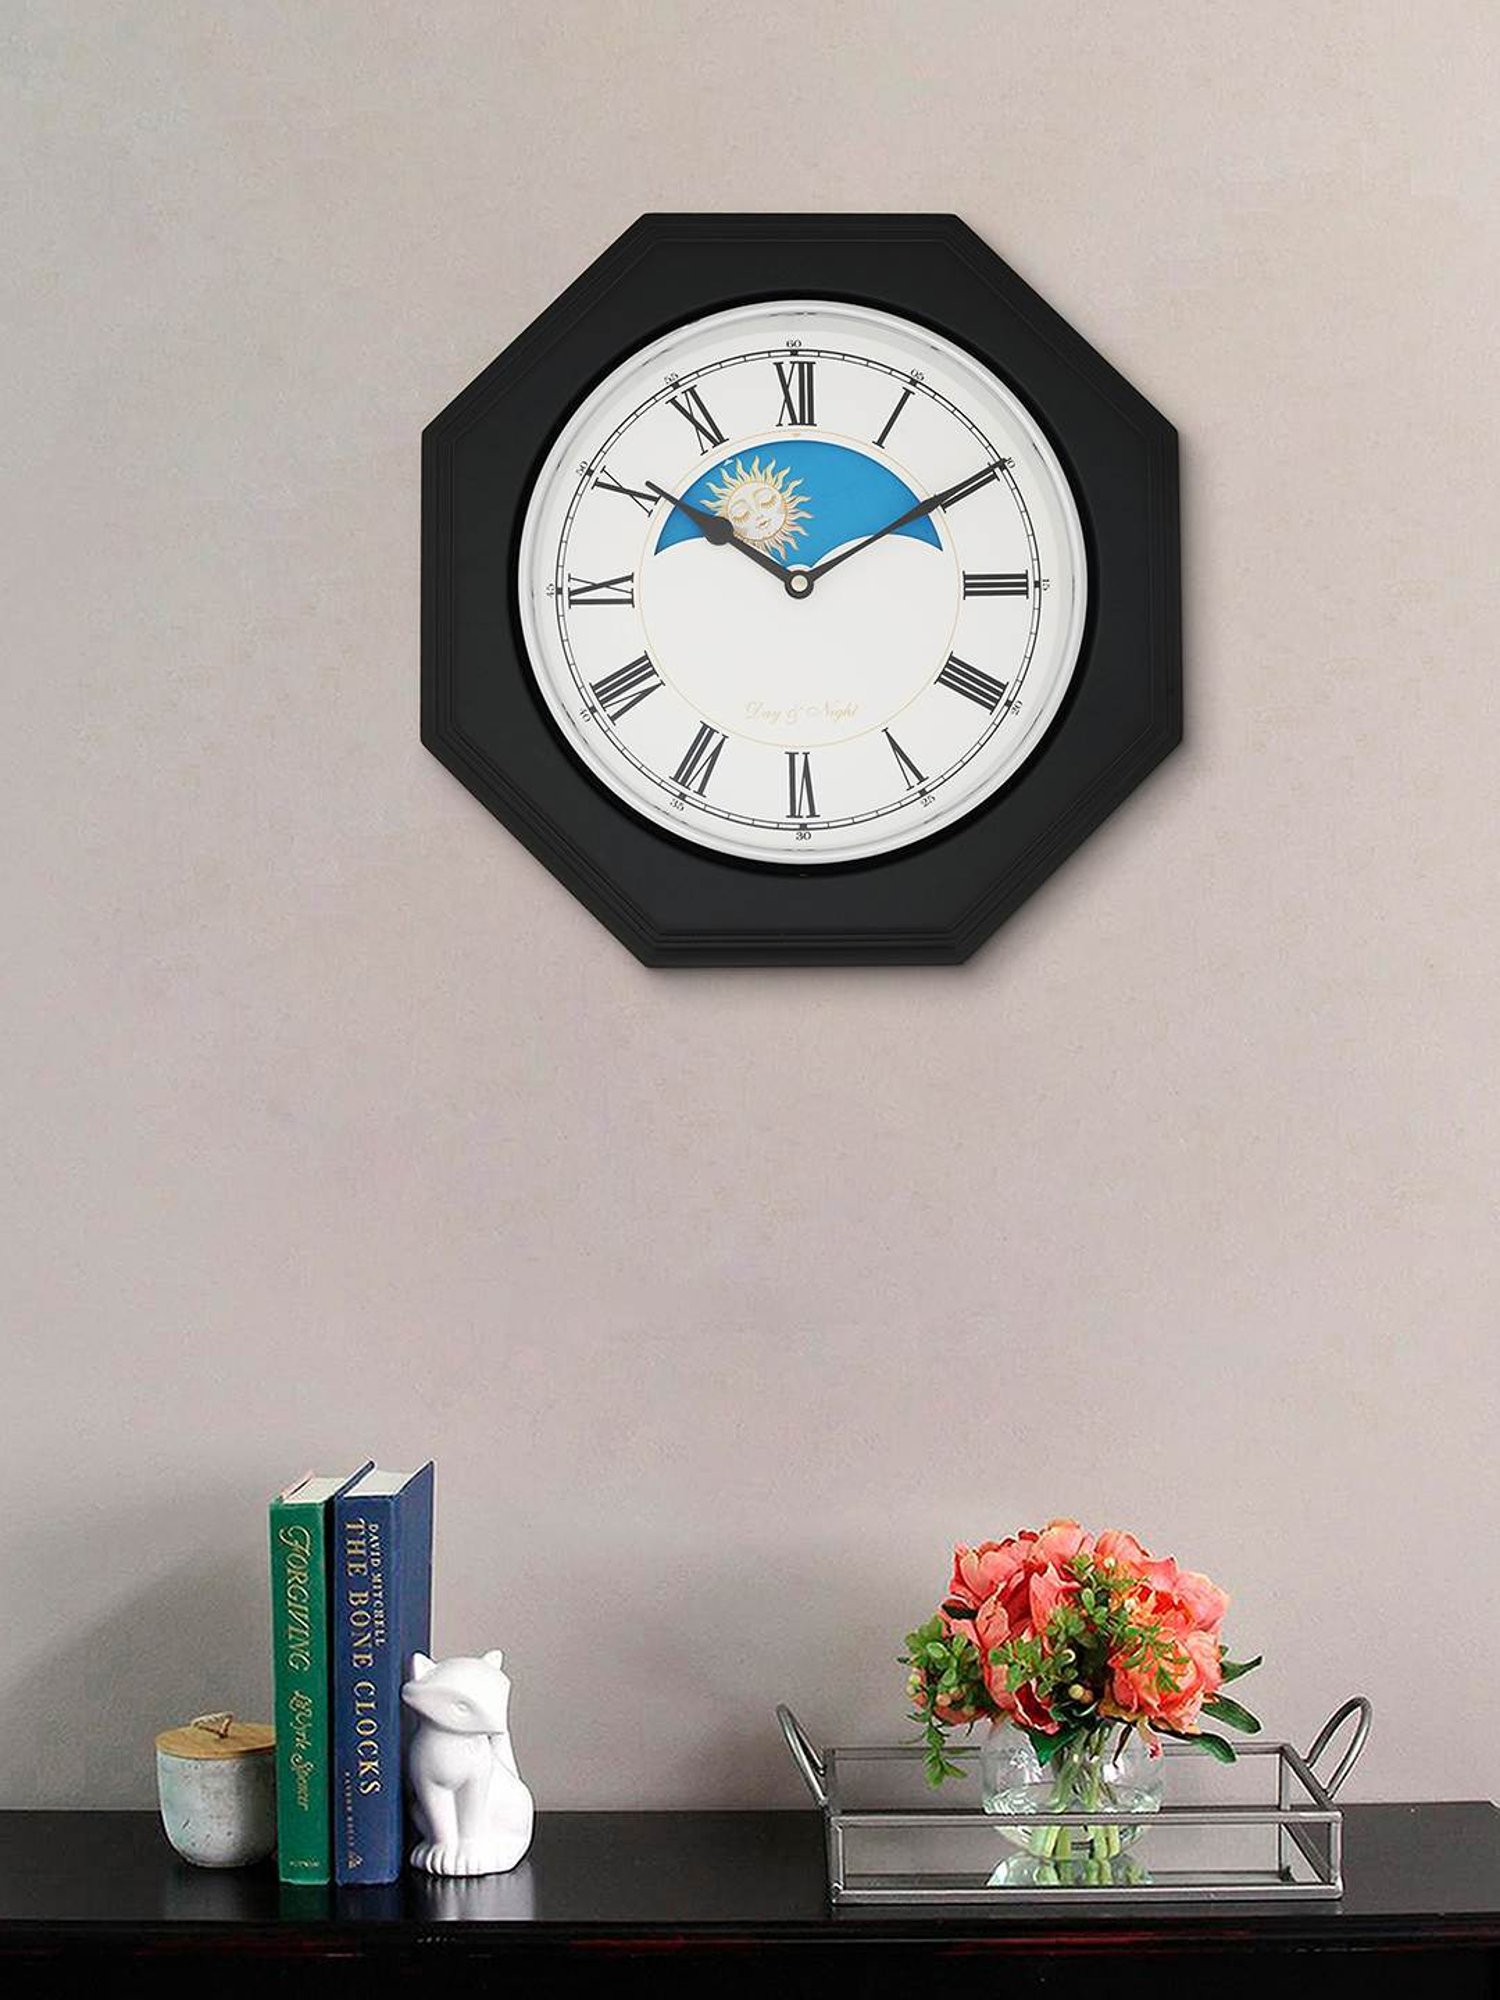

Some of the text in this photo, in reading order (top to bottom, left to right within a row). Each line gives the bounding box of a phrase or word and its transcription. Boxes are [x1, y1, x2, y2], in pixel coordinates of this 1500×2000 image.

[786, 339, 802, 348] 60
[663, 372, 679, 385] 55
[773, 361, 816, 427] XII
[910, 368, 925, 382] 05
[665, 385, 729, 456] XI
[872, 386, 916, 449] I
[591, 465, 663, 518] X
[568, 572, 635, 609] IX
[962, 569, 1029, 601] III
[1042, 578, 1051, 592] 15
[589, 650, 666, 726] VIII
[933, 650, 1009, 716] IIII
[1010, 699, 1024, 716] 20
[669, 720, 729, 798] VII
[785, 752, 820, 819] VI
[881, 727, 929, 791] V
[669, 798, 685, 812] 35
[920, 793, 936, 808] 25
[795, 831, 812, 841] 30
[279, 1525, 312, 1674] FORGIVING
[368, 1523, 387, 1647] DAVID MITCHELL
[346, 1517, 383, 1795] THE BONE CLOCKS
